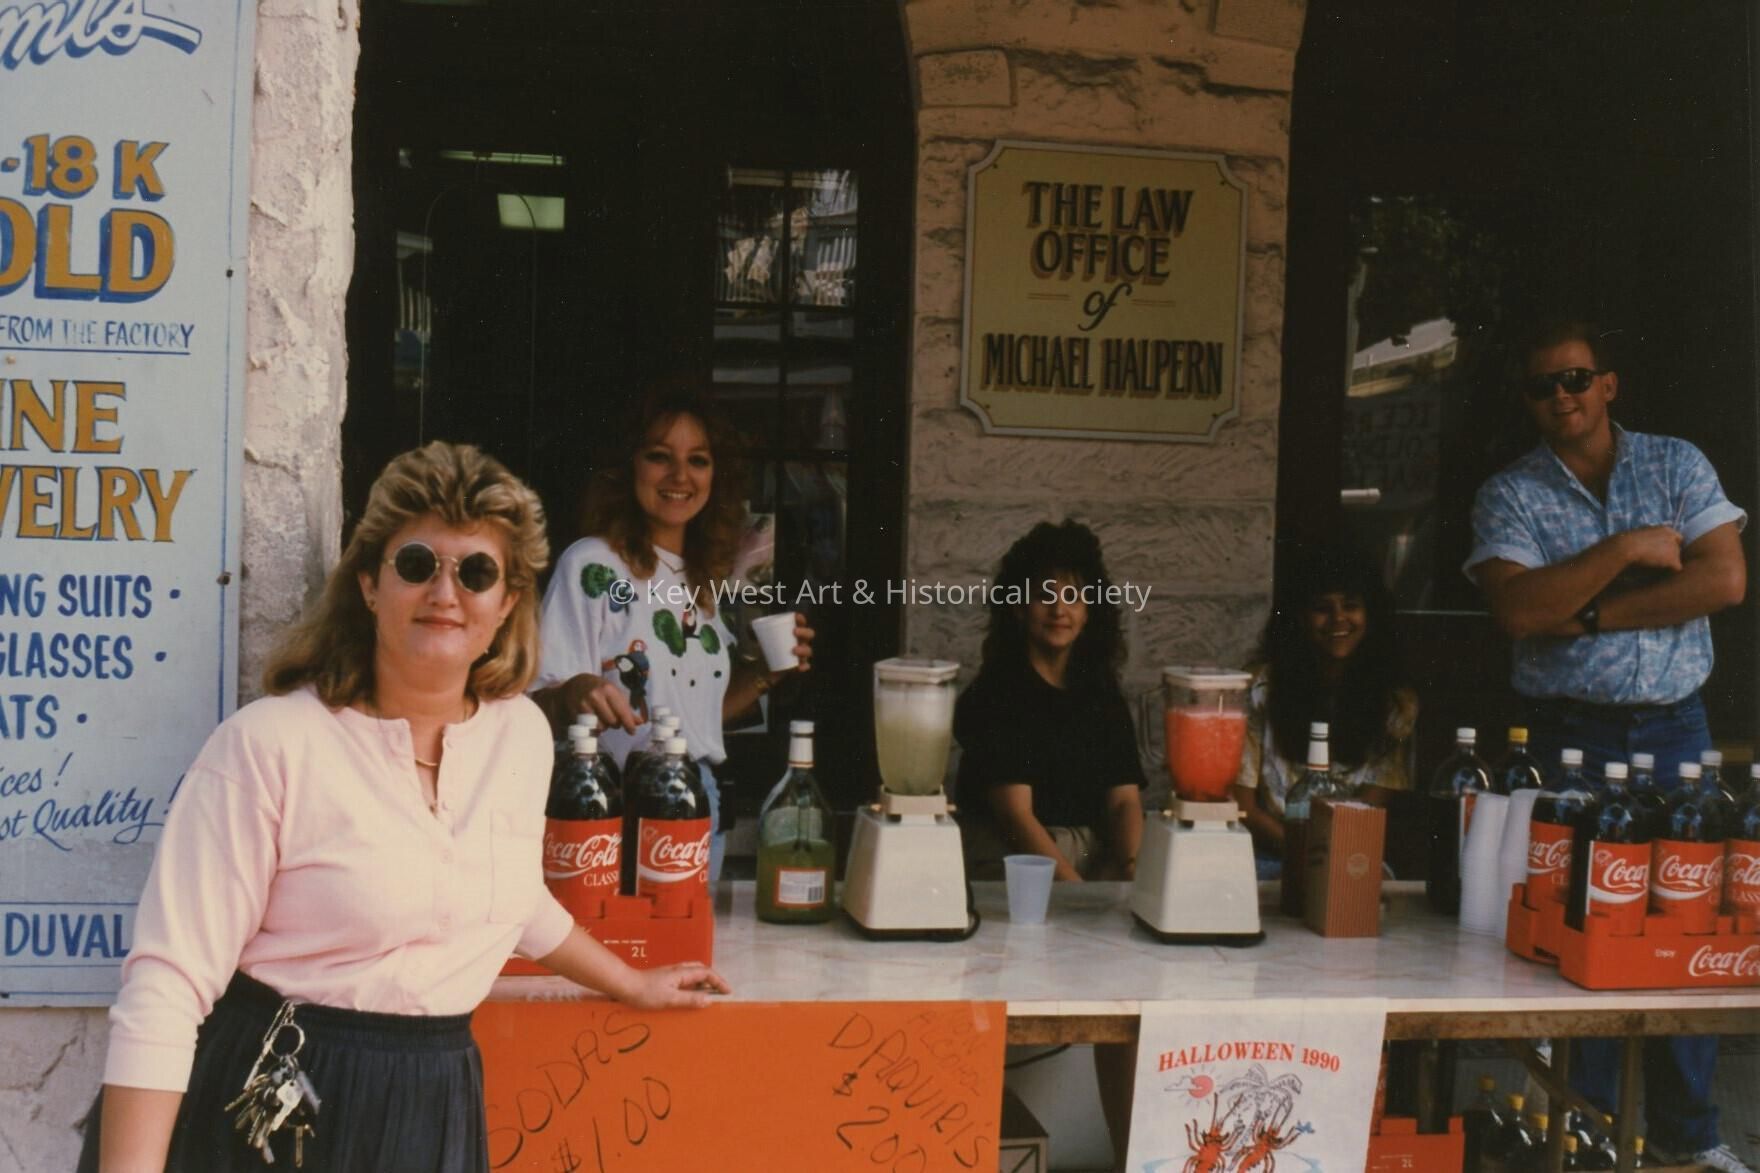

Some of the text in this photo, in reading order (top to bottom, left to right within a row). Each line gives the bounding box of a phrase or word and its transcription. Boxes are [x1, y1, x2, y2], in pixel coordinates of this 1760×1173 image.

[113, 139, 170, 201] K
[1024, 181, 1195, 238] THE LAW
[1030, 230, 1171, 286] OFFICE
[1078, 282, 1133, 331] of
[62, 319, 97, 344] THE
[104, 321, 195, 349] FACTORY
[980, 332, 1225, 399] MICHAEL HALPERN
[58, 573, 152, 618] SUITS
[4, 912, 131, 958] DUVAL
[1157, 1041, 1341, 1073] HALLOWEEN 1990
